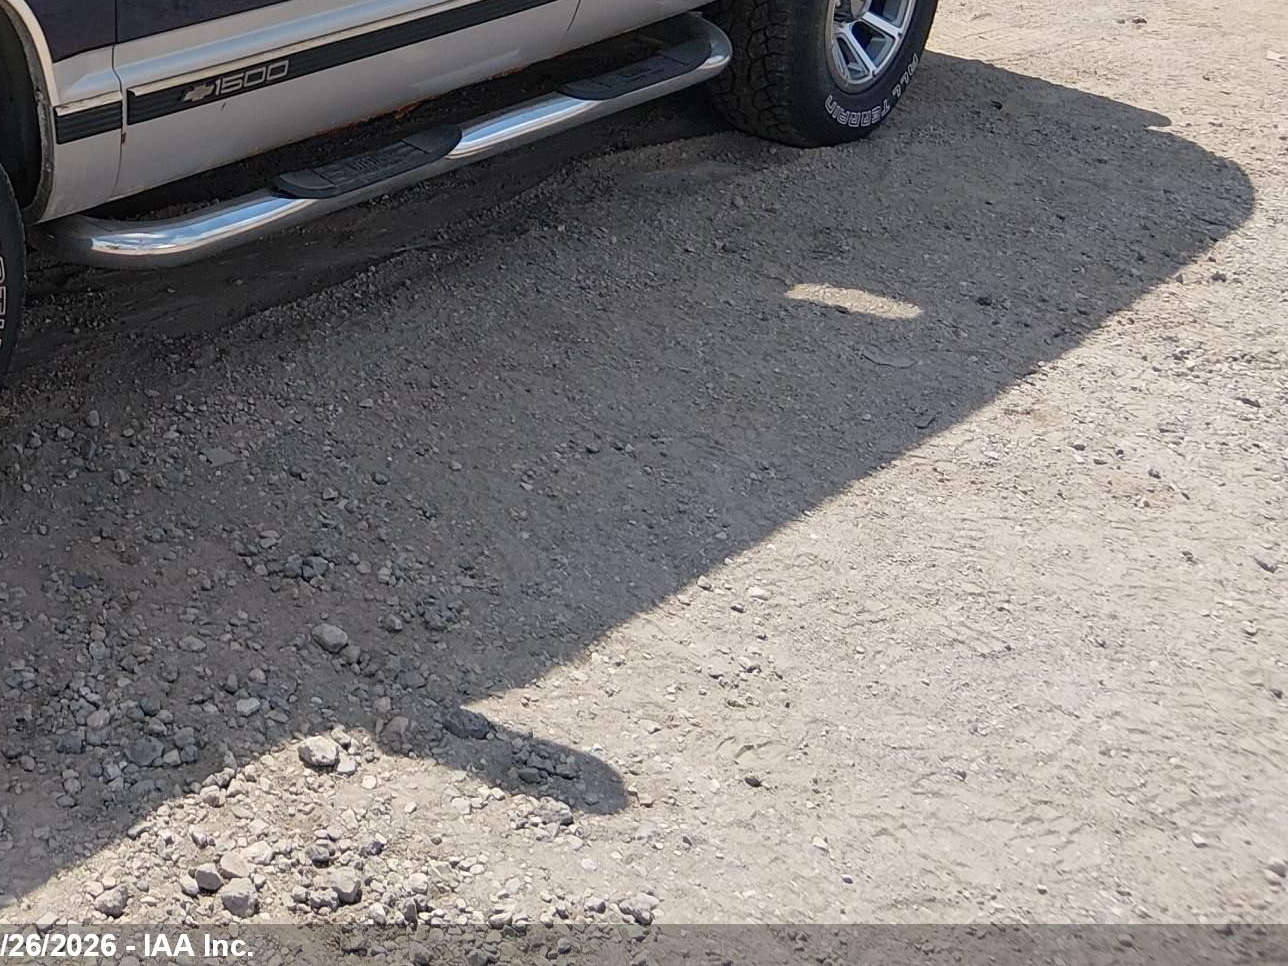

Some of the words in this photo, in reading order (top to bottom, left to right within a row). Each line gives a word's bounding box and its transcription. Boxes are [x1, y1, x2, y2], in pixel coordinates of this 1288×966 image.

[214, 59, 289, 96] 1500
[892, 52, 919, 98] ALL
[824, 94, 891, 128] TERRAIN
